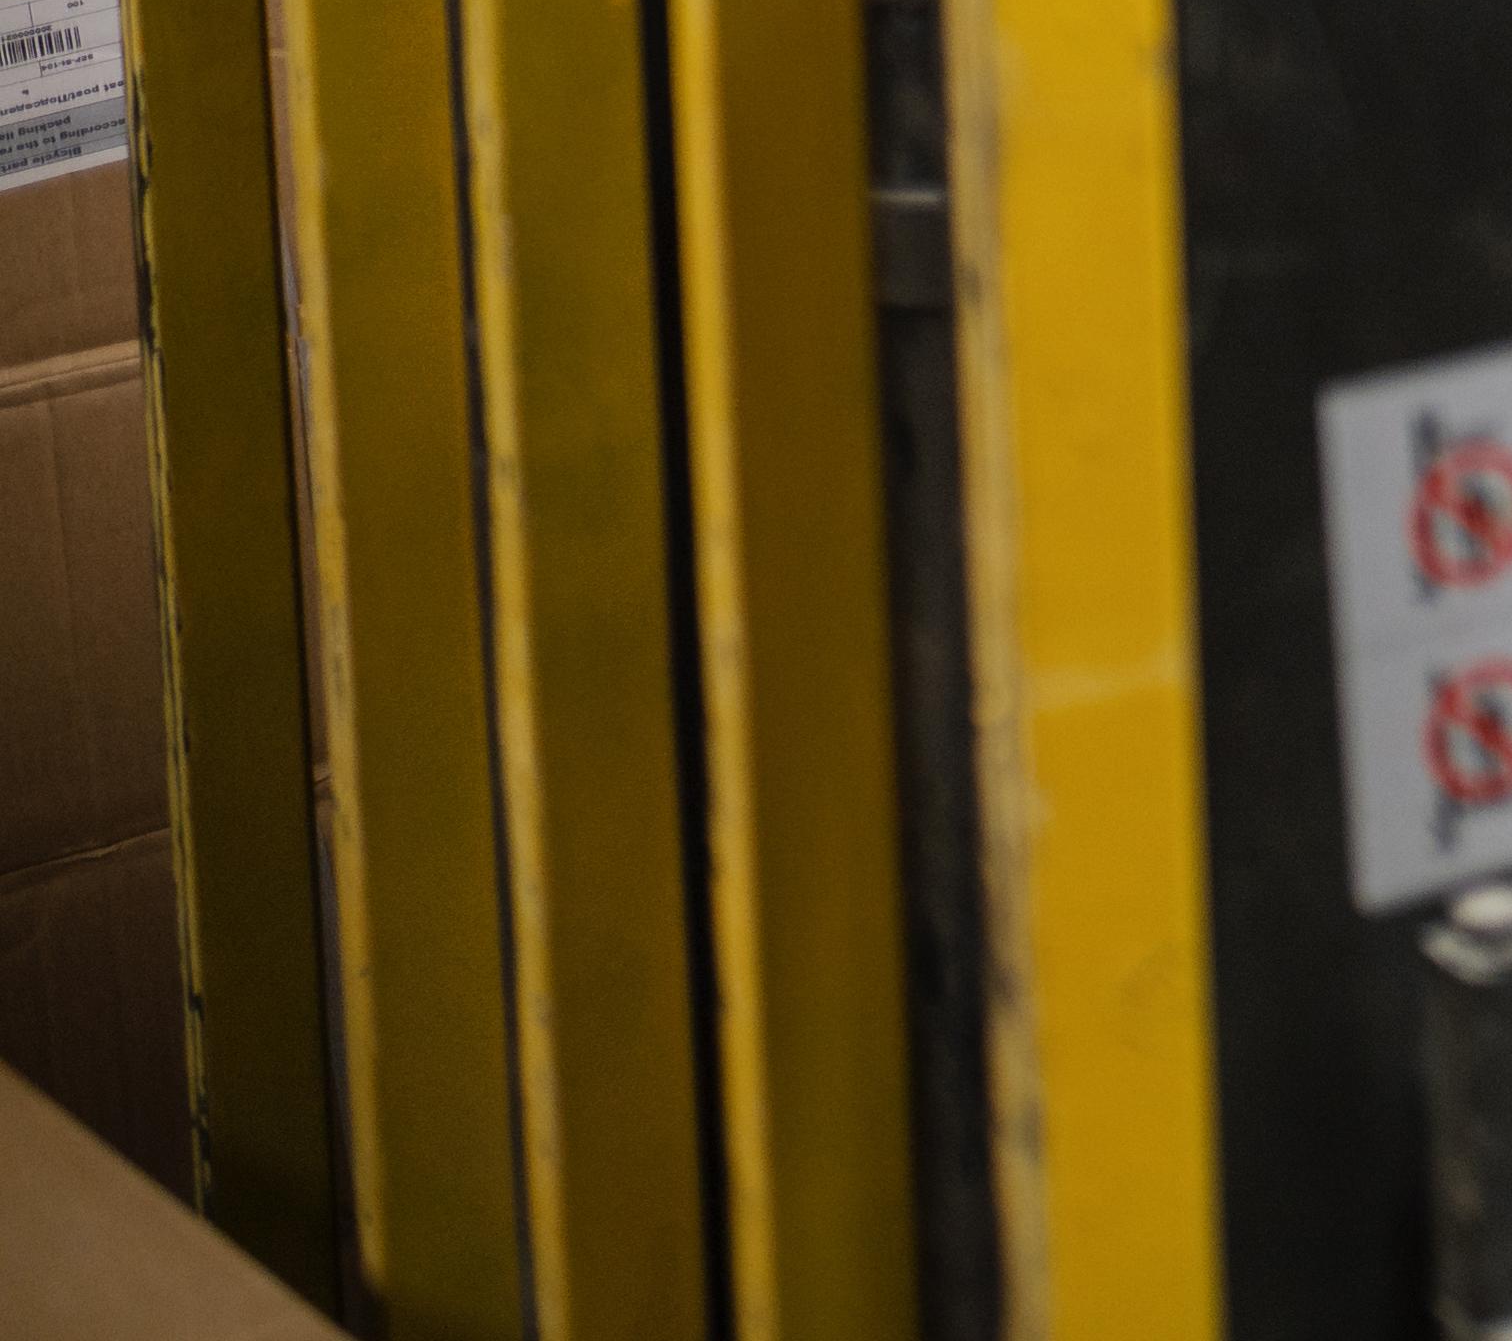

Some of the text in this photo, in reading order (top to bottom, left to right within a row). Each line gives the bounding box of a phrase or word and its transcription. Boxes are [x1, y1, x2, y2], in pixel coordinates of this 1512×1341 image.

[103, 80, 125, 92] eat
[18, 115, 71, 137] packing
[60, 118, 126, 140] according
[16, 140, 40, 152] the
[43, 136, 56, 146] to
[0, 146, 82, 177] Bicycle part
